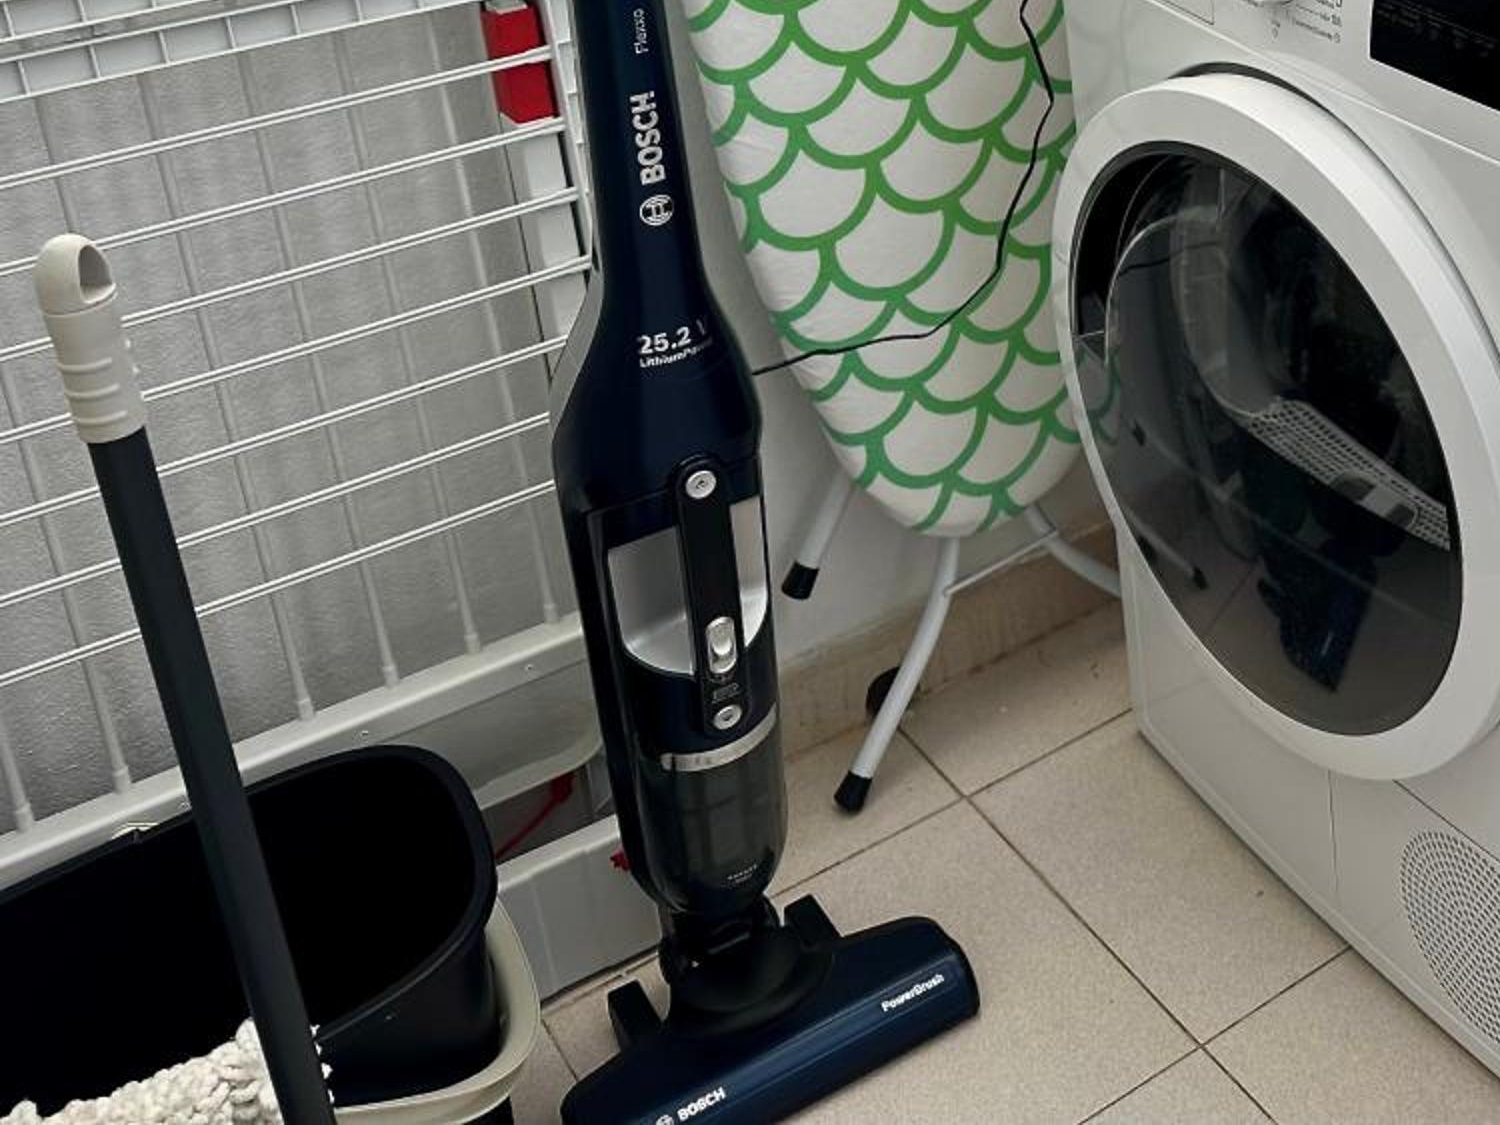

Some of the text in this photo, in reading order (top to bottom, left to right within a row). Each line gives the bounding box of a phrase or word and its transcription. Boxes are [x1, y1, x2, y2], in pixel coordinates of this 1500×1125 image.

[629, 90, 667, 186] BOSCH
[637, 326, 692, 355] 25.2
[677, 1085, 727, 1123] BOSCH
